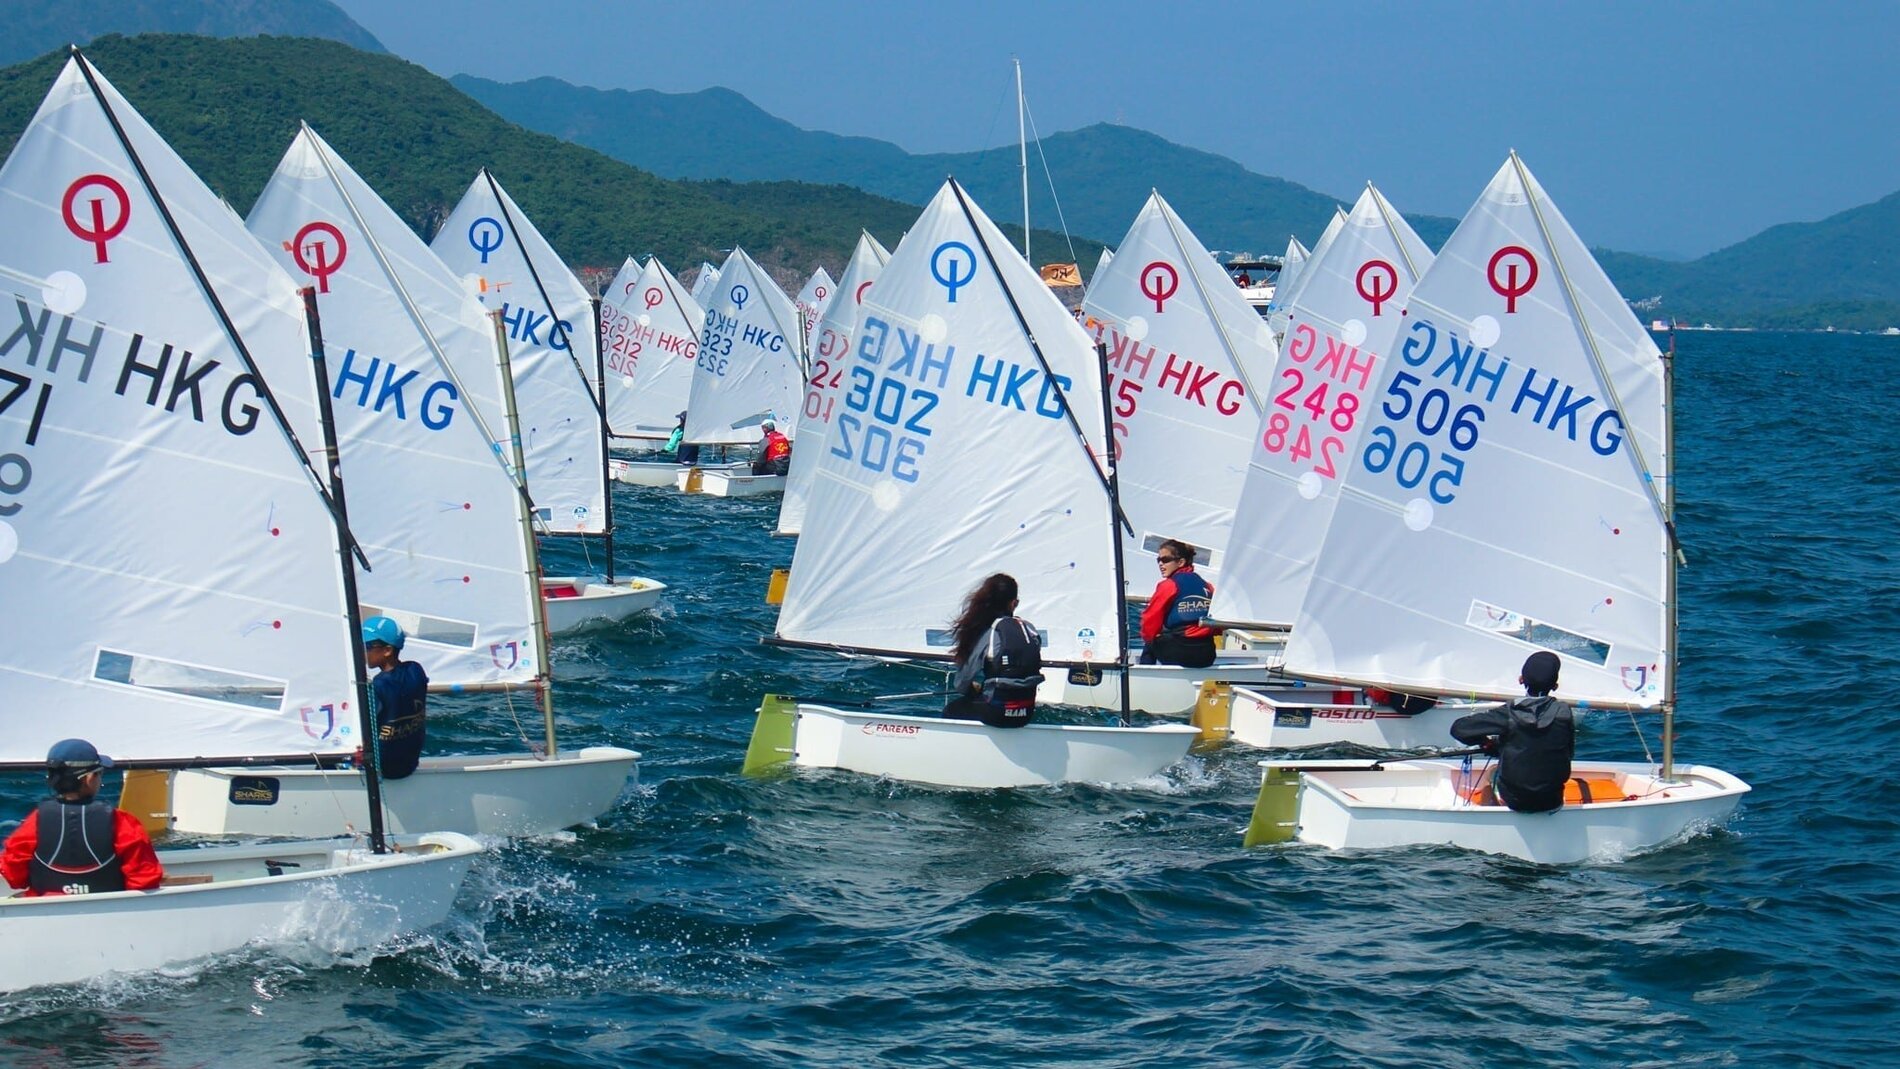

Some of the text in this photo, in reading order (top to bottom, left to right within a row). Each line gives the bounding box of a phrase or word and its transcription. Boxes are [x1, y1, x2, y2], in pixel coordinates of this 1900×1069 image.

[612, 334, 642, 359] 212
[657, 332, 698, 359] HKG
[701, 329, 733, 356] 323
[742, 324, 784, 352] HKG
[115, 333, 265, 436] HKG
[333, 349, 458, 431] HKG
[846, 365, 940, 437] 302
[966, 354, 1072, 420] HKG
[1157, 353, 1245, 416] HKG
[1274, 368, 1359, 432] 248
[1382, 370, 1485, 452] 506
[1510, 367, 1626, 456] HKG
[1005, 708, 1026, 717] SLAM
[1319, 707, 1376, 720] astro
[235, 791, 272, 799] SHARKS
[62, 883, 89, 894] Gill
